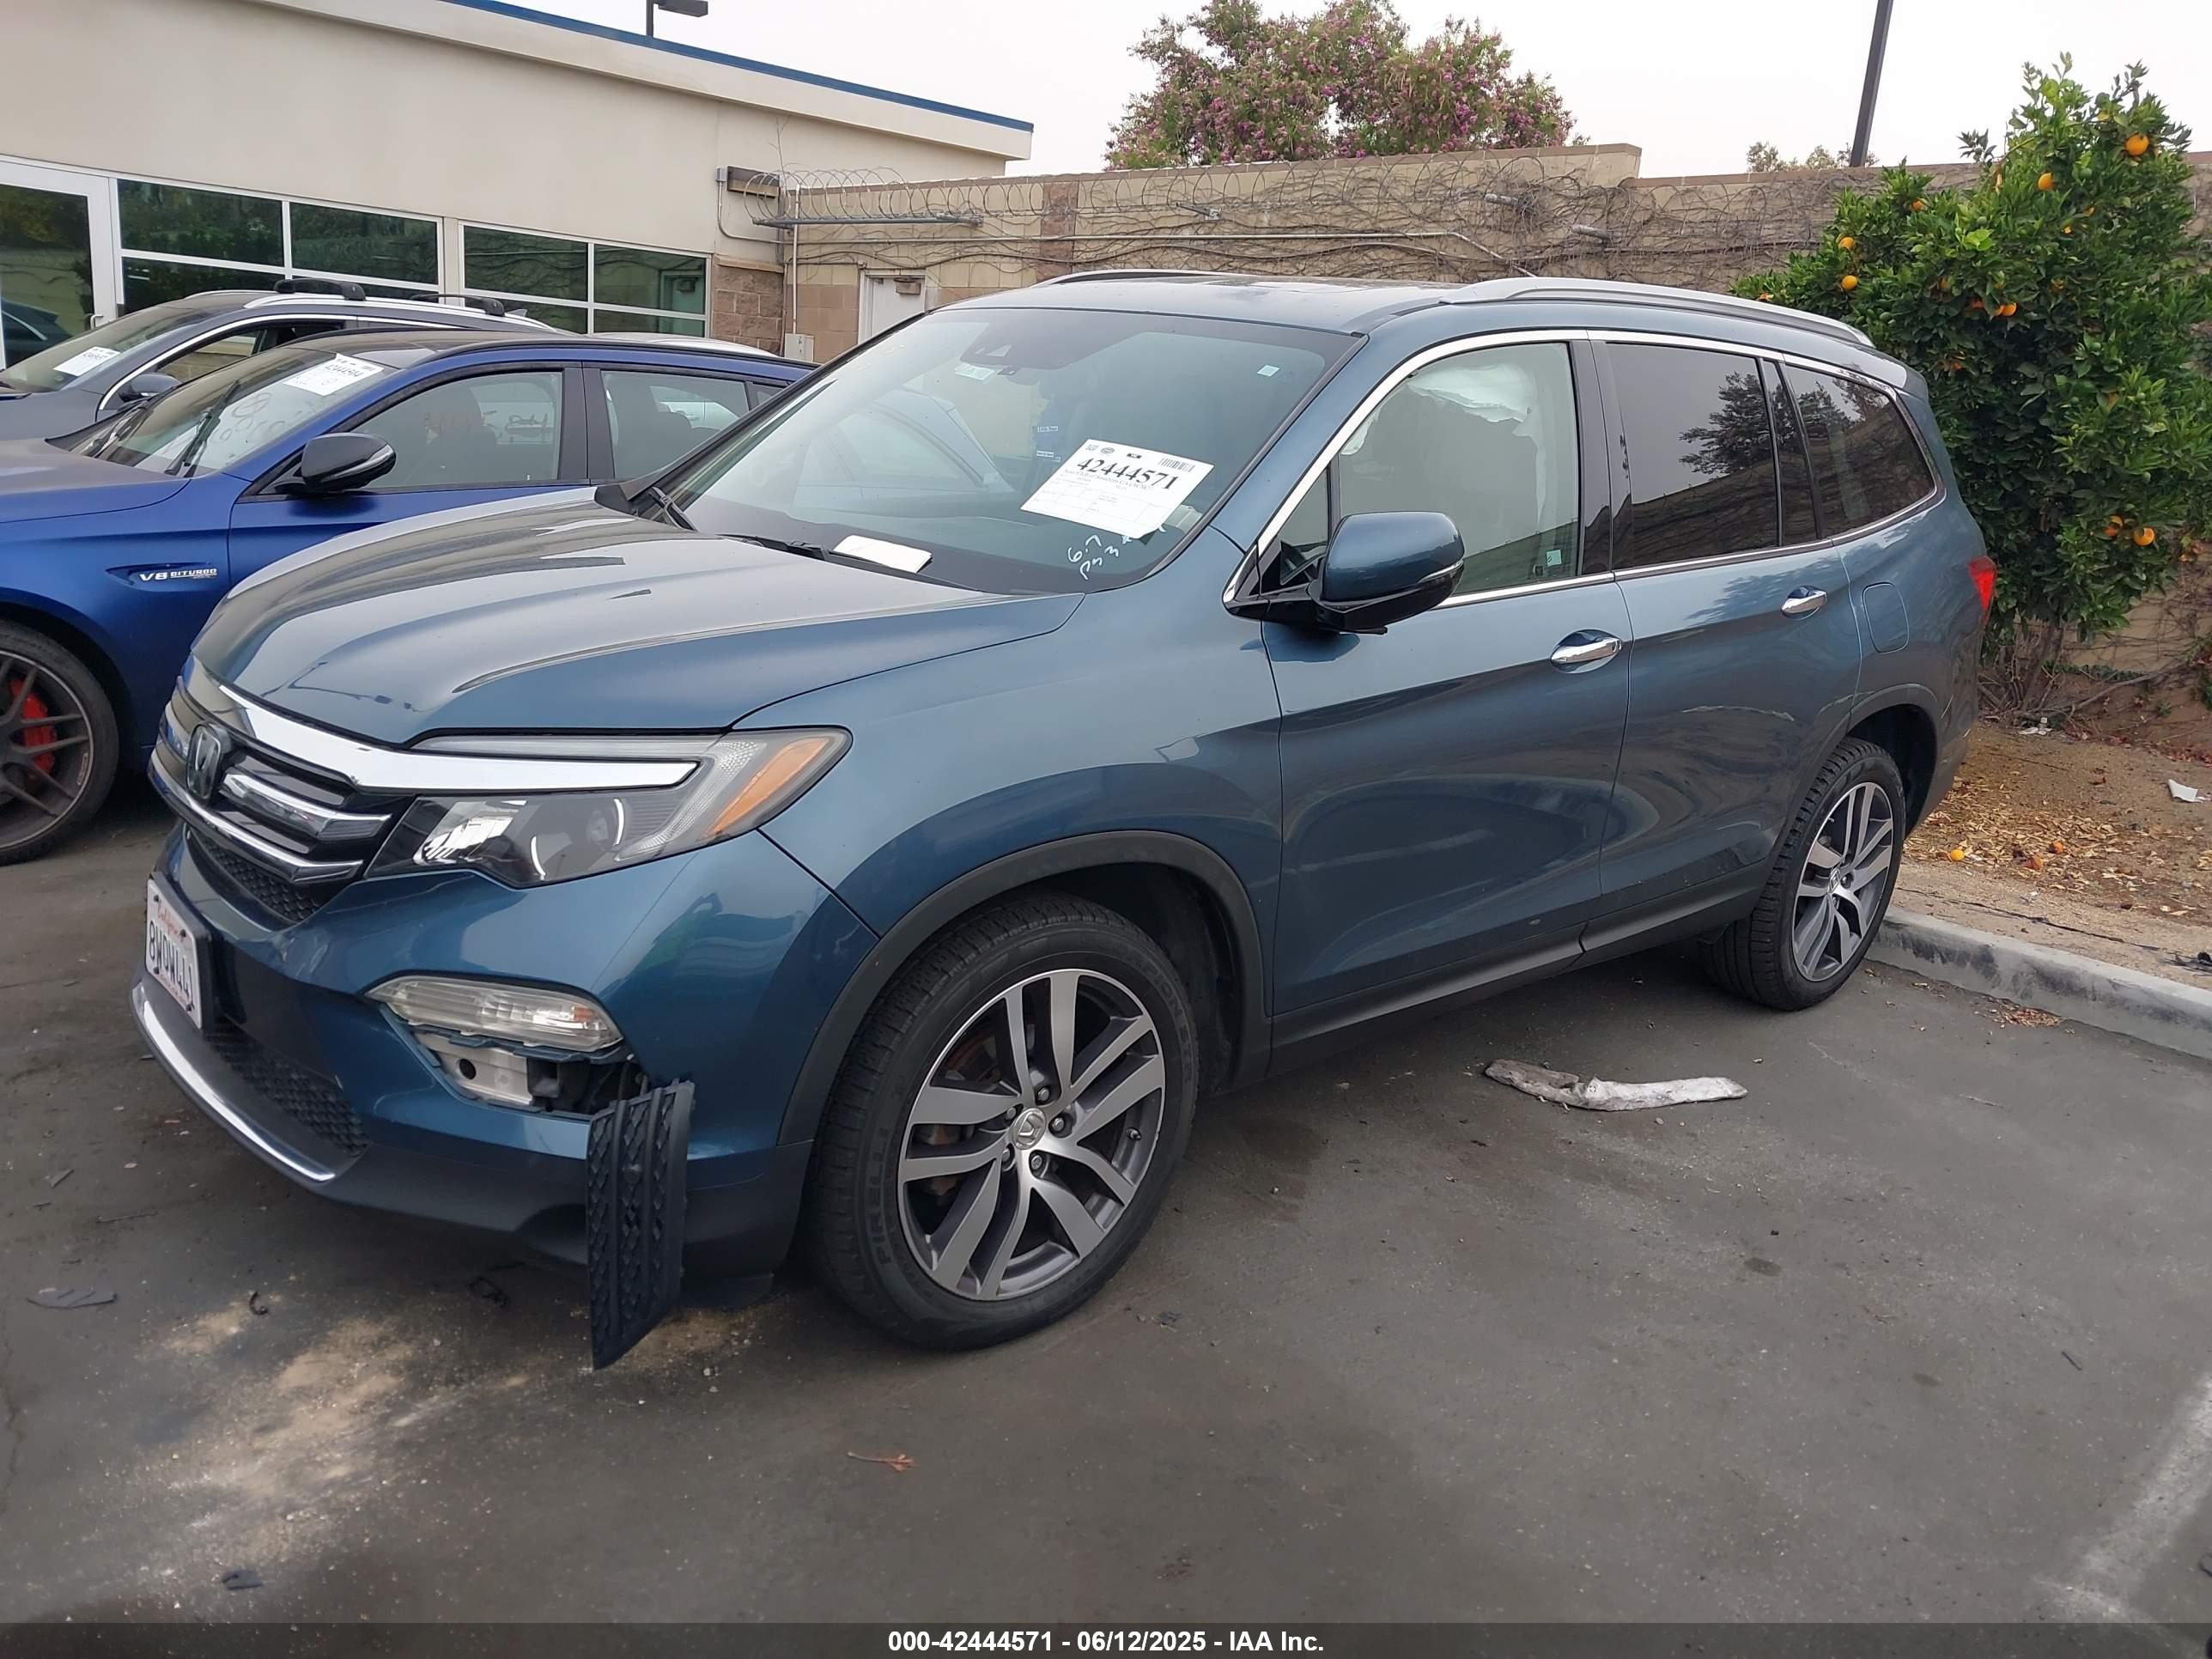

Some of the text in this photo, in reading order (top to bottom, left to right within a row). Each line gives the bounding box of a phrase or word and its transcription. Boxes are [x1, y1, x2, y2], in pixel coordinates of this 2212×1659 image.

[1077, 458, 1180, 490] 42444571
[139, 572, 168, 581] V8
[170, 568, 217, 578] BITURBO
